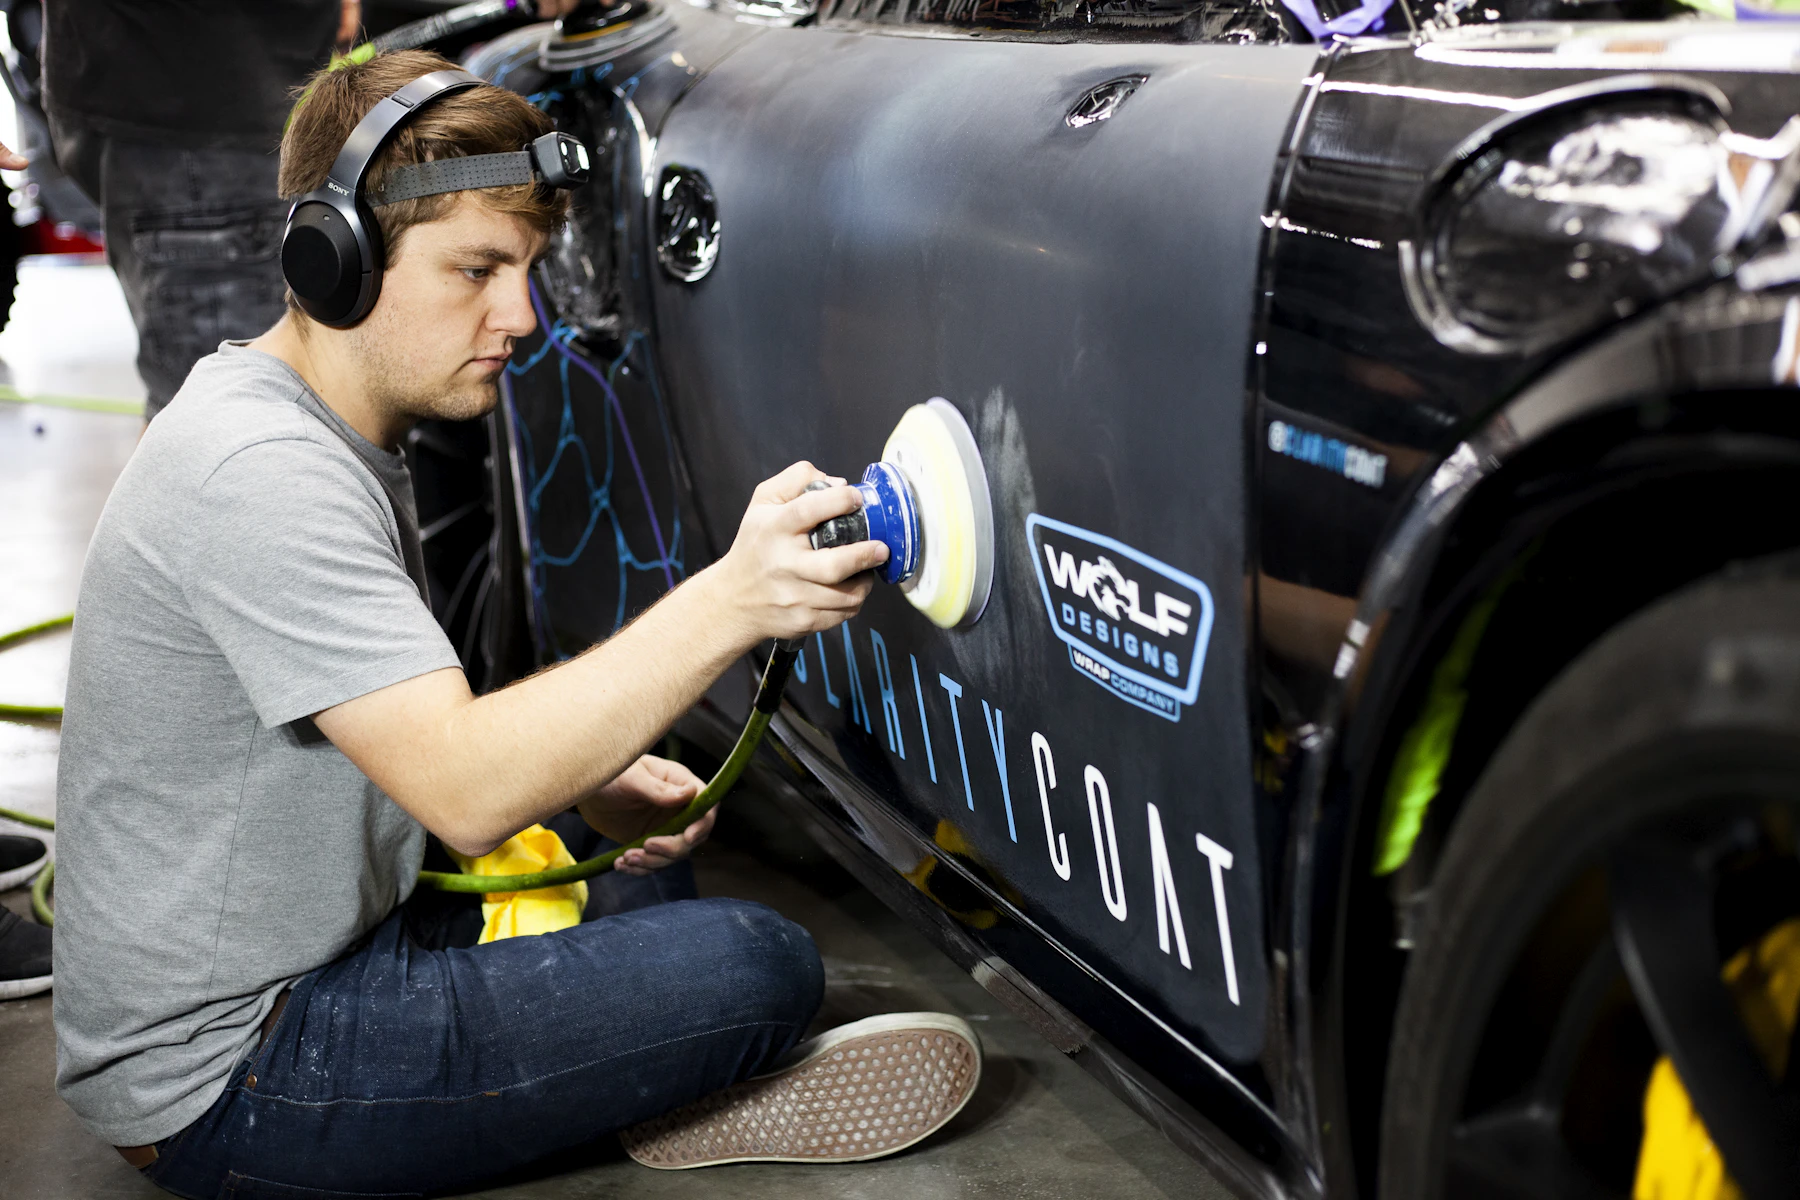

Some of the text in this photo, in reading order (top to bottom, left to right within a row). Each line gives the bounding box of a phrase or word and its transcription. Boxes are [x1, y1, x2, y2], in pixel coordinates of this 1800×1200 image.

[327, 182, 350, 197] SONY
[1043, 543, 1192, 637] WOLF
[1061, 602, 1180, 678] DESIGNS
[1072, 649, 1175, 713] WRAP COMPANY
